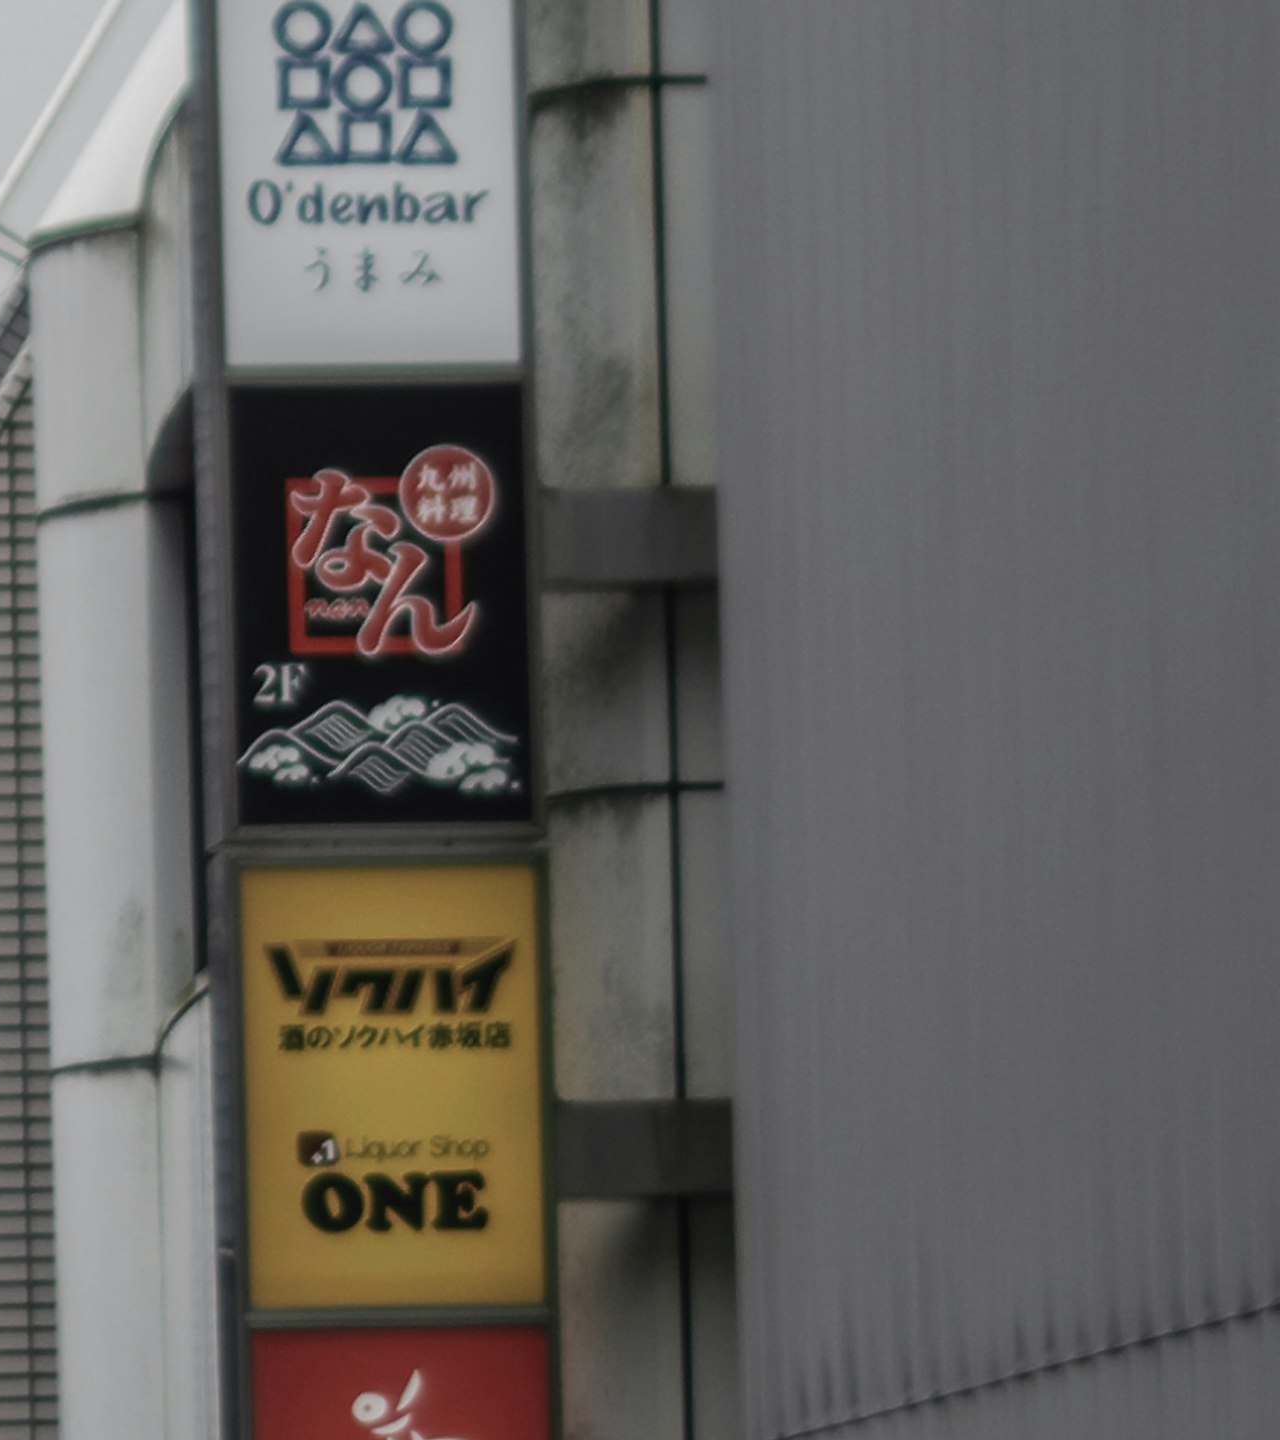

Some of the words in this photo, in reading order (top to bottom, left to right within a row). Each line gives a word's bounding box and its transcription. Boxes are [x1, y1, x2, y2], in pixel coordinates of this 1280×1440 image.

[247, 178, 491, 226] O'denbar
[305, 247, 442, 292] うまみ
[416, 464, 478, 492] 九州
[416, 495, 478, 523] 料理
[291, 468, 476, 656] なん
[252, 662, 308, 704] 2F
[264, 939, 515, 1016] ソクハイ
[280, 1023, 513, 1051] 酒のソクハイ赤坂店
[345, 1135, 421, 1163] Liquor
[429, 1134, 490, 1162] Shop
[301, 1171, 489, 1233] ONE
